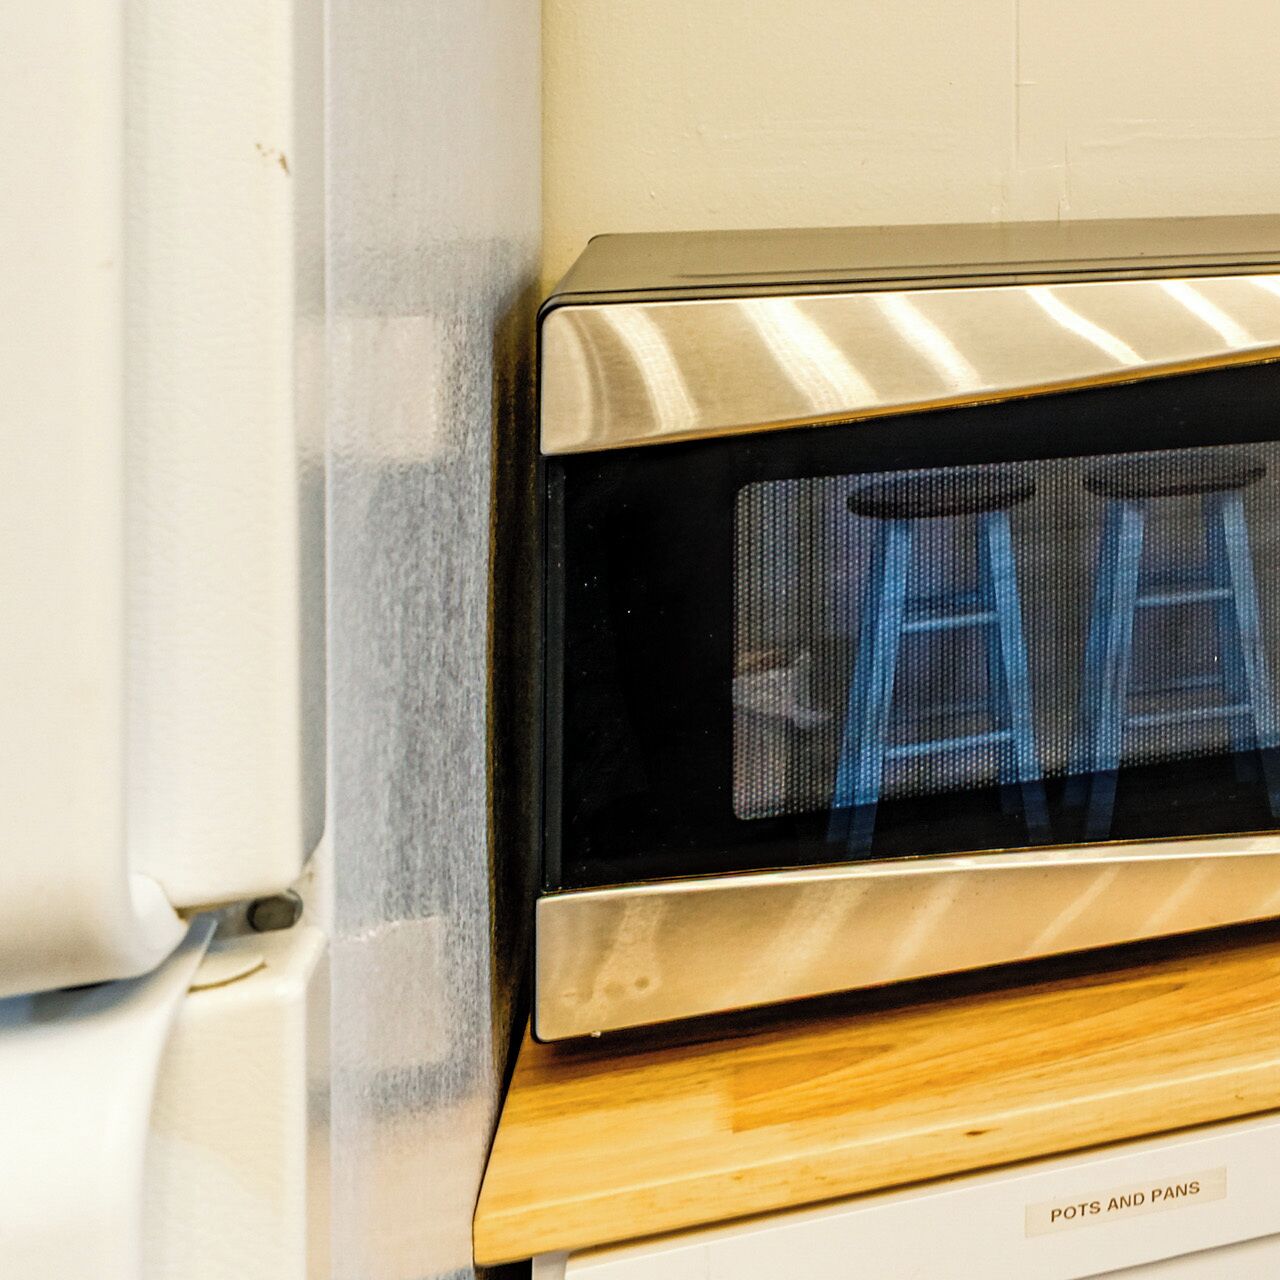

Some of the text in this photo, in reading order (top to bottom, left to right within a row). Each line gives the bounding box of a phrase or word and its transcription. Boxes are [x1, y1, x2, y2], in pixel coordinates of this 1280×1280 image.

[1051, 1181, 1200, 1223] POTS AND PANS
